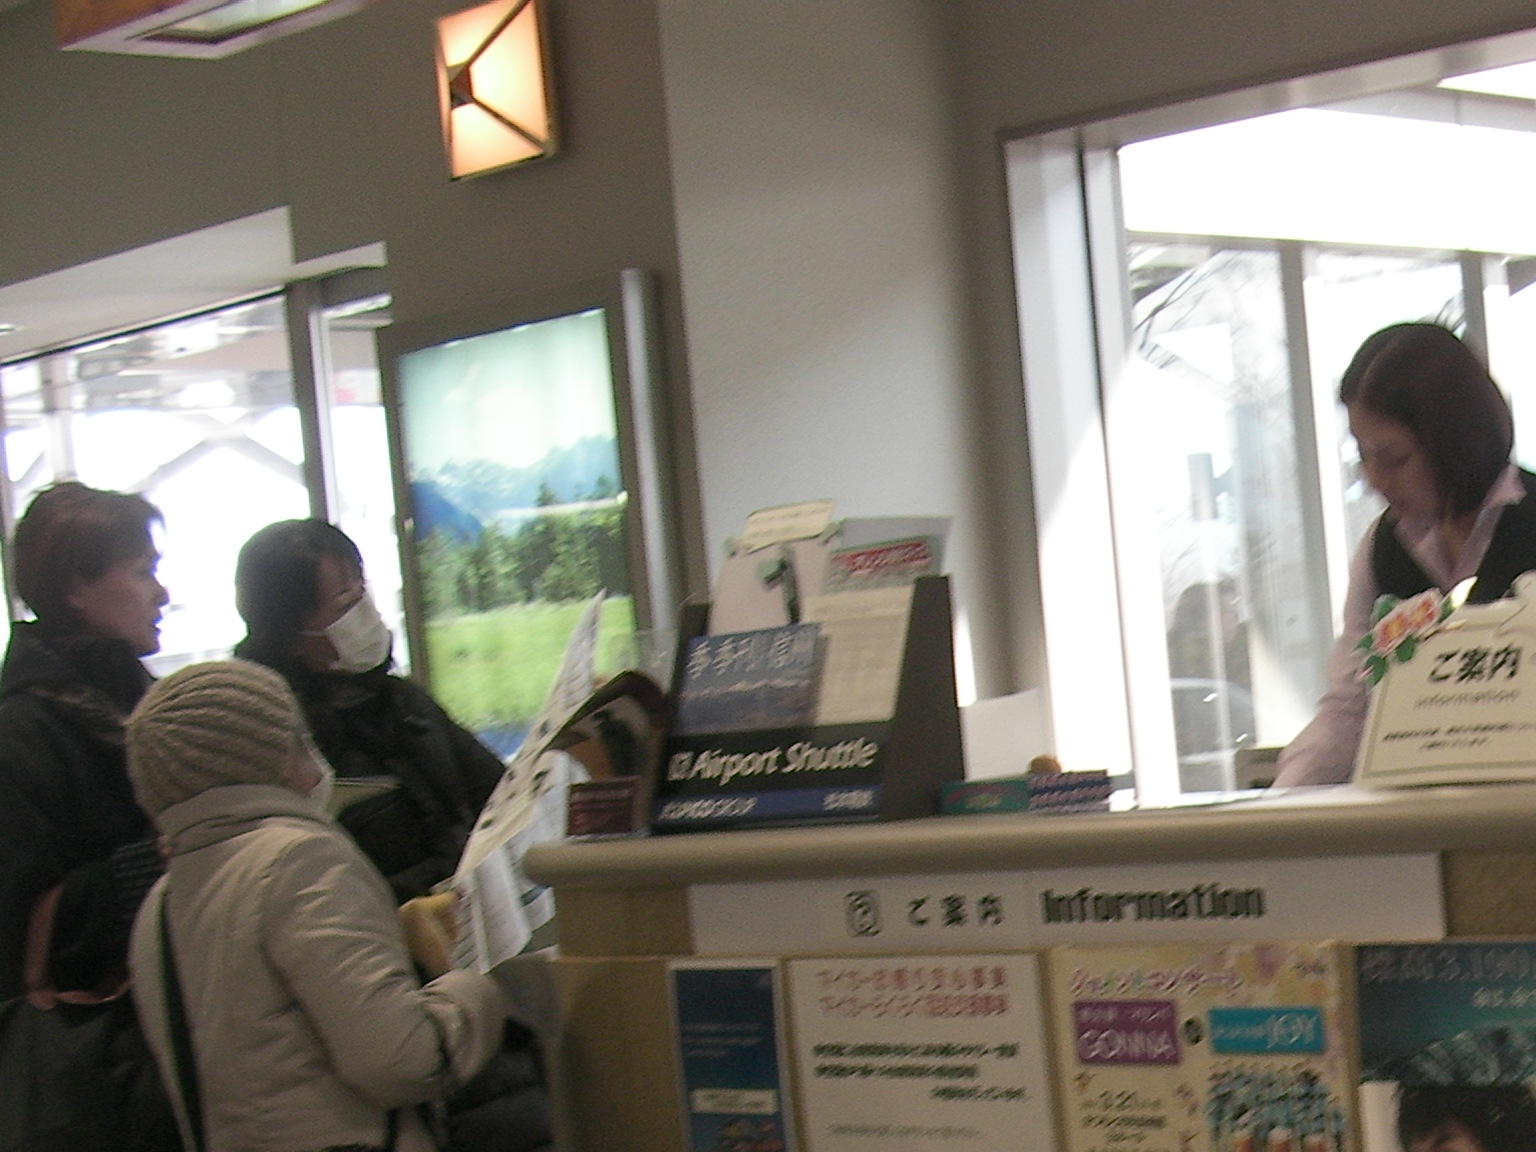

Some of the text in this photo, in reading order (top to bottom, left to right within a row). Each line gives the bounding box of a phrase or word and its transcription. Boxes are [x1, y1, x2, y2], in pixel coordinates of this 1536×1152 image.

[1427, 642, 1525, 685] ご案内
[687, 737, 879, 786] Airport Shuttle
[907, 893, 1004, 928] ご案内
